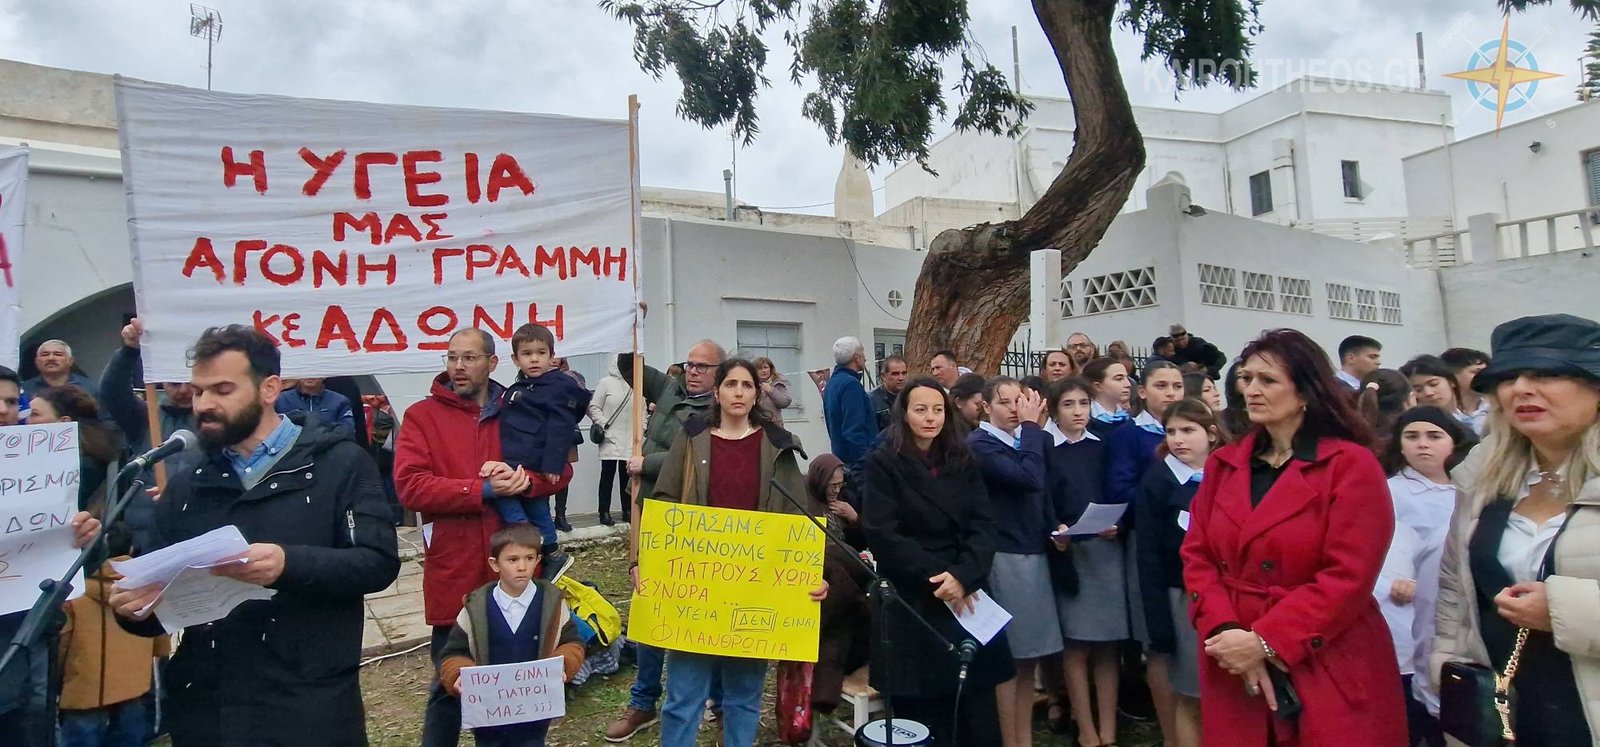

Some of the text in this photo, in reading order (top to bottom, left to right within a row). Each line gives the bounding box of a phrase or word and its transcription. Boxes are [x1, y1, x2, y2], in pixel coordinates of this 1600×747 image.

[222, 146, 536, 206] Η ΥΓΕΙΑ
[333, 211, 454, 245] ΜΑΣ
[182, 236, 628, 288] ΑΓΟΝΗ ΓΡΑΜΜΗ
[0, 469, 80, 496] ΡΙΣΜΟΣ
[664, 504, 816, 543] ΦΤΑΣΑΜΕ ΝΑ
[640, 531, 823, 567] ΠΕΡΙΜΕΝΟΥΜΕ ΤΟΥΣ
[667, 556, 761, 583] ΓΙΑΤΡΟΥΣ
[638, 578, 708, 603] ΣΥΝΟΡΑ
[652, 601, 817, 630] Η ΥΓΕΙΑ ΔΕΝ ΕΙΝΑΙ
[470, 666, 549, 686] ΠΟΥ ΕΙΝΑΙ
[468, 684, 547, 704] ΟΙ ΓΙΑΤΡΟΙ
[486, 704, 526, 719] ΜΑΣ
